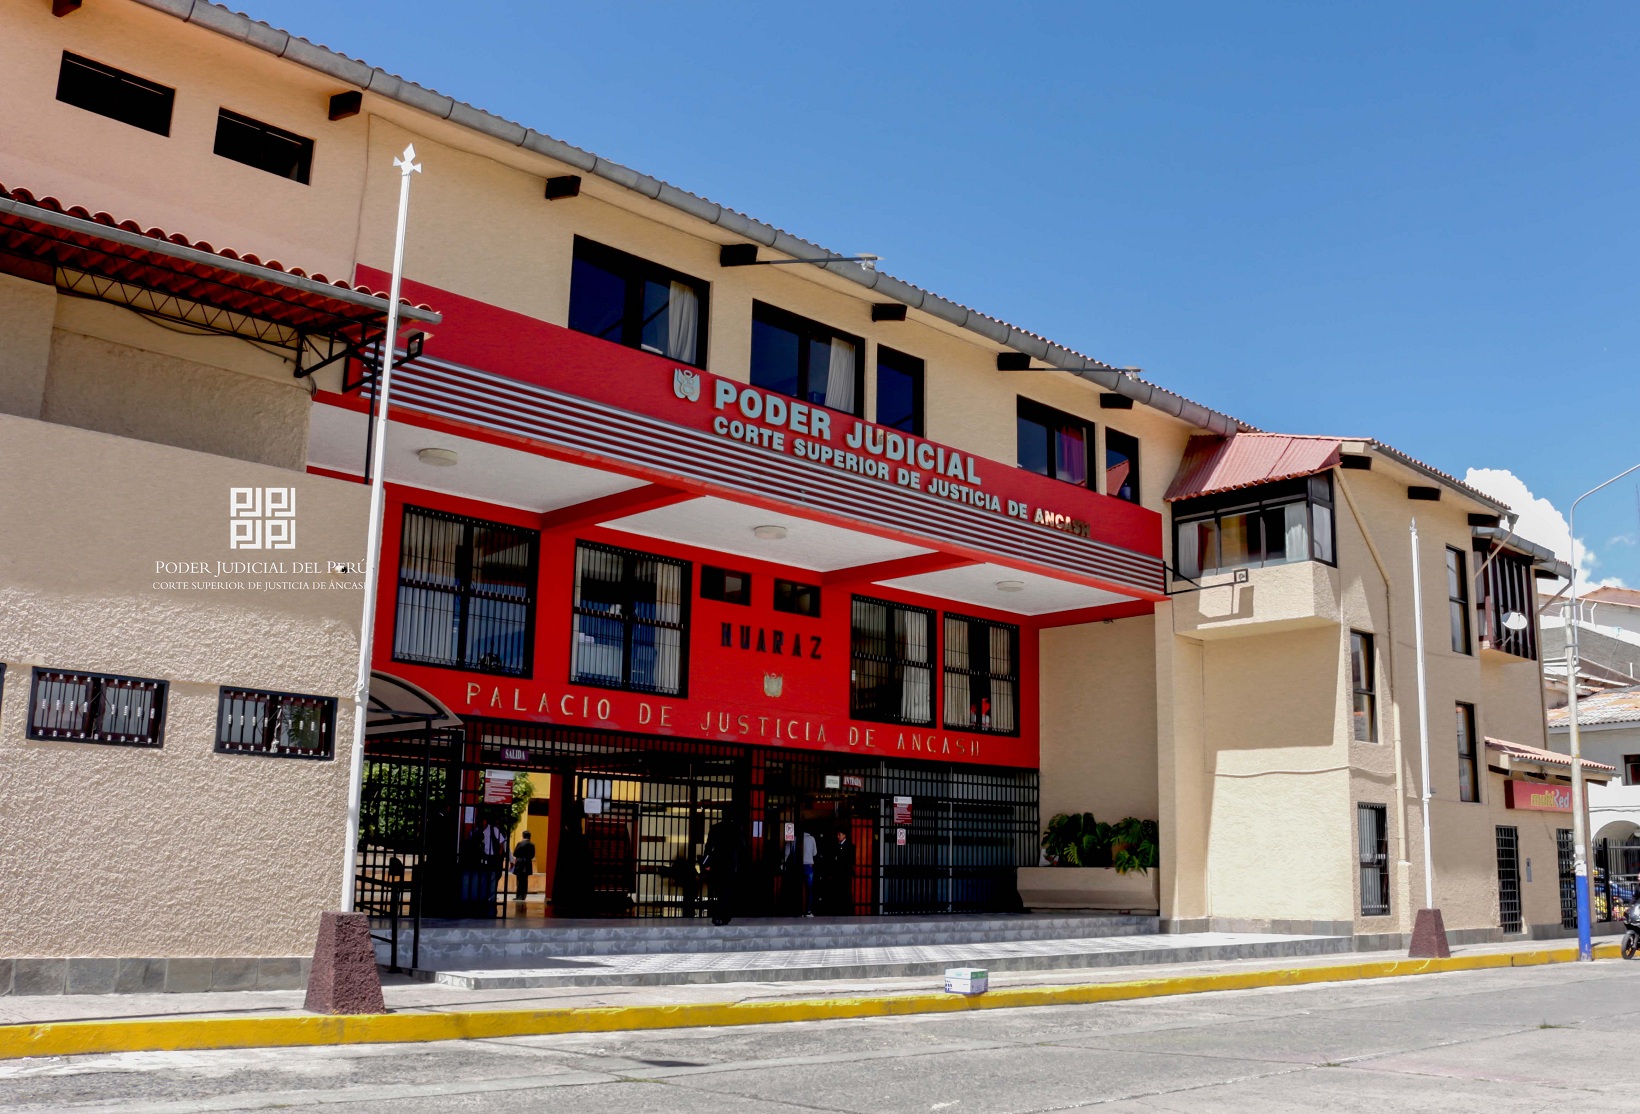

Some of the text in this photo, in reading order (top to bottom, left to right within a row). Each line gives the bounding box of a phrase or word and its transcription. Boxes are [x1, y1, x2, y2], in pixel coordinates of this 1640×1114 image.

[714, 379, 982, 485] PODER JUDICIAL
[714, 416, 1091, 538] CORTE SUPERIOR DE JUSTICIA DE ANCASH
[721, 622, 822, 659] HUARAZ
[466, 682, 980, 757] PALACIO DE JUSTICIA DE ANCASH
[505, 749, 526, 760] SALIDA
